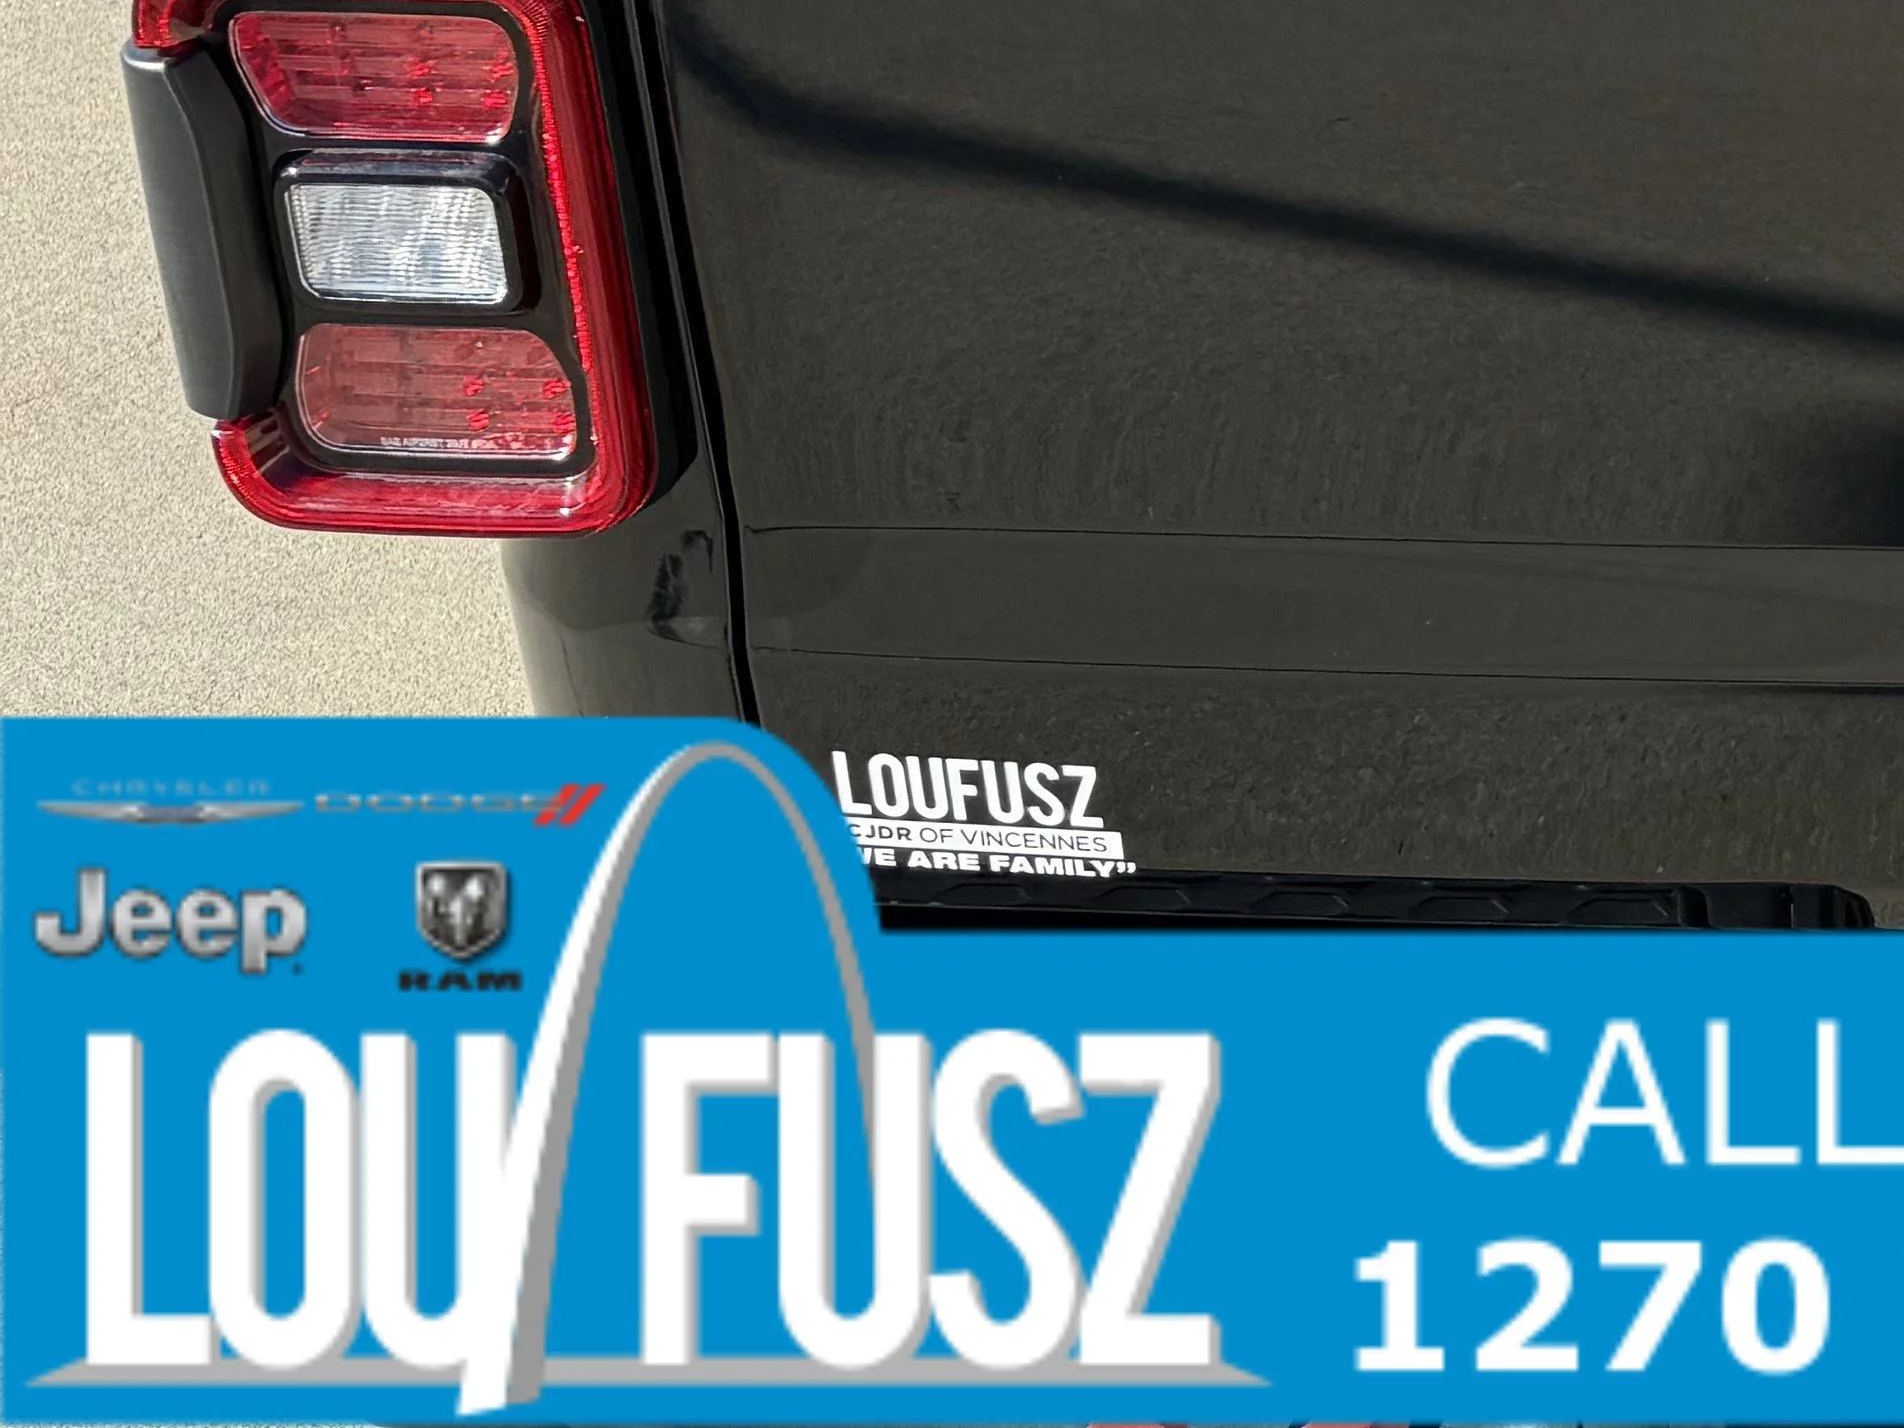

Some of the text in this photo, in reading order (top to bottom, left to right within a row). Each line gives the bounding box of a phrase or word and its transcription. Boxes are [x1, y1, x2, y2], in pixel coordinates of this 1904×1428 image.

[831, 750, 1104, 829] LOUFUSZ
[849, 823, 1107, 852] CJDR OF VINCENNES
[907, 850, 981, 871] ARE
